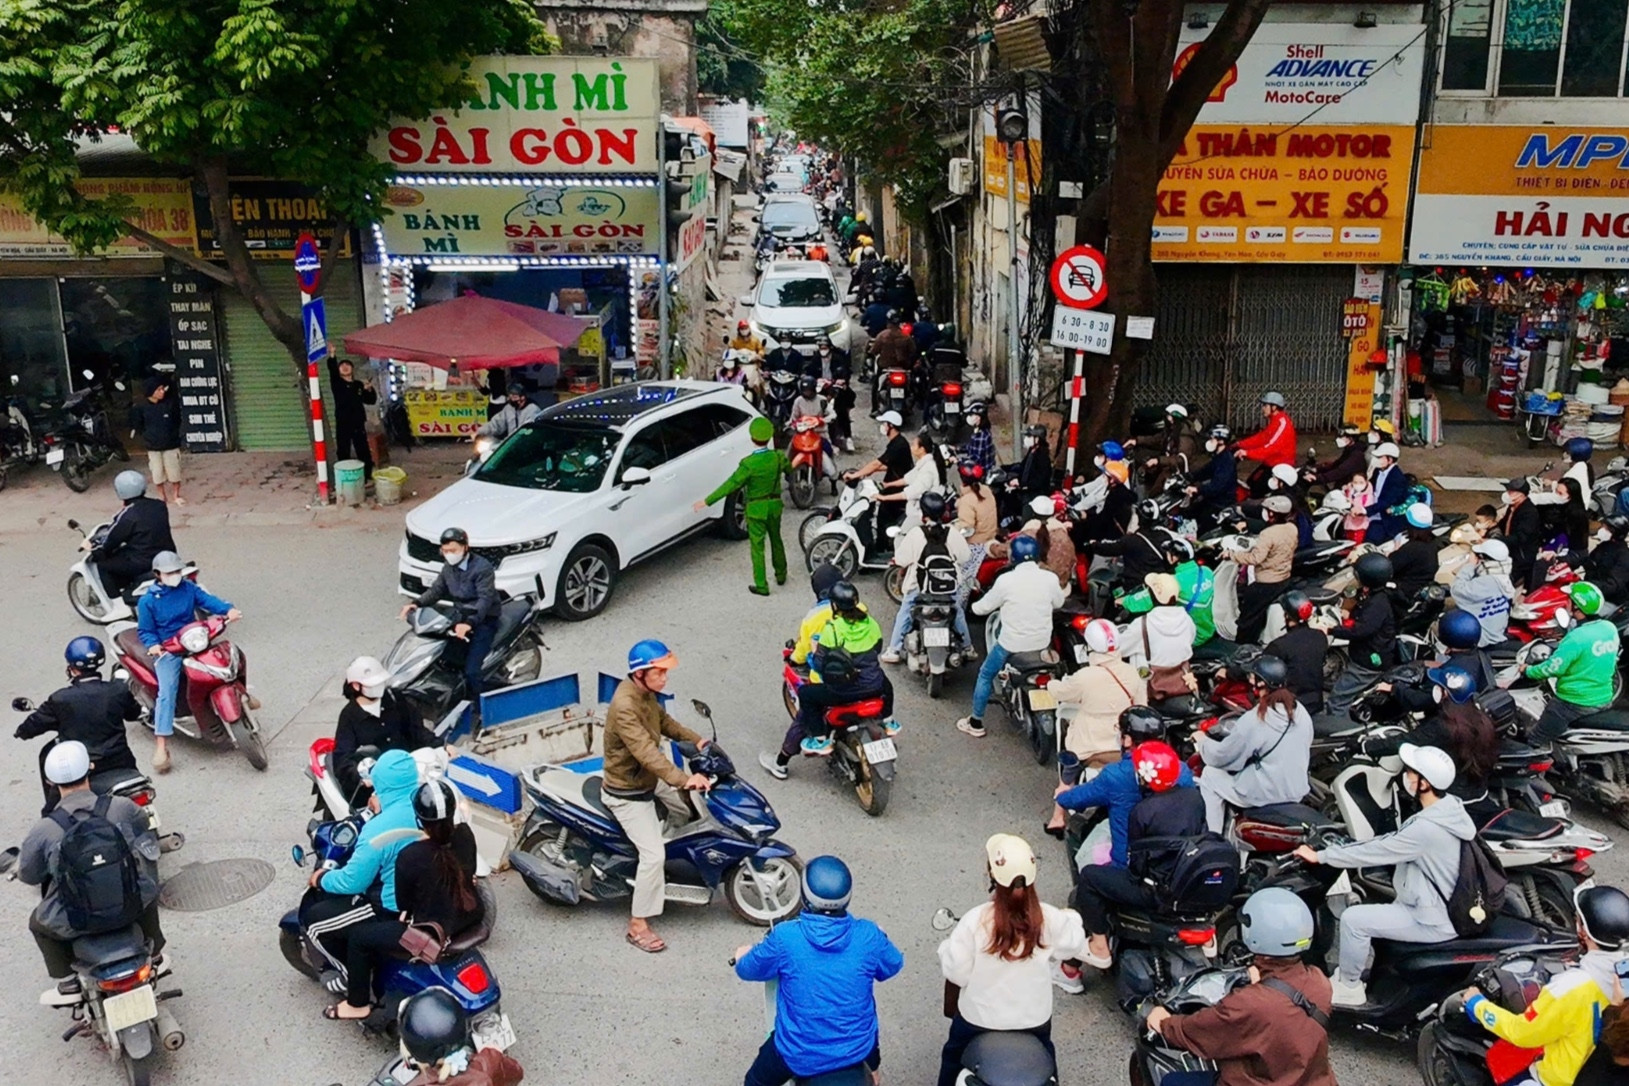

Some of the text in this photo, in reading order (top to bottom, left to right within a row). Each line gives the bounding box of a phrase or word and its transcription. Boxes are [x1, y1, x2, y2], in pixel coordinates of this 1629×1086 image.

[1286, 44, 1324, 58] Shell
[1265, 60, 1377, 78] ADVANCE
[571, 62, 628, 111] MÌ
[1265, 90, 1341, 104] MotoCare
[388, 116, 638, 165] SÀI GÒN
[1196, 128, 1278, 158] THÂN
[1286, 133, 1392, 158] MOTOR
[1514, 133, 1629, 169] MP
[1200, 190, 1247, 218] GA
[1288, 191, 1330, 219] XE
[1344, 182, 1390, 219] SỐ
[171, 207, 189, 231] 38
[403, 210, 481, 231] BÁNH
[504, 221, 645, 238] SÀI GÒN
[1495, 201, 1568, 237] HẢI
[423, 233, 460, 253] MÌ
[189, 358, 204, 369] PIN
[419, 420, 452, 433] SÀI
